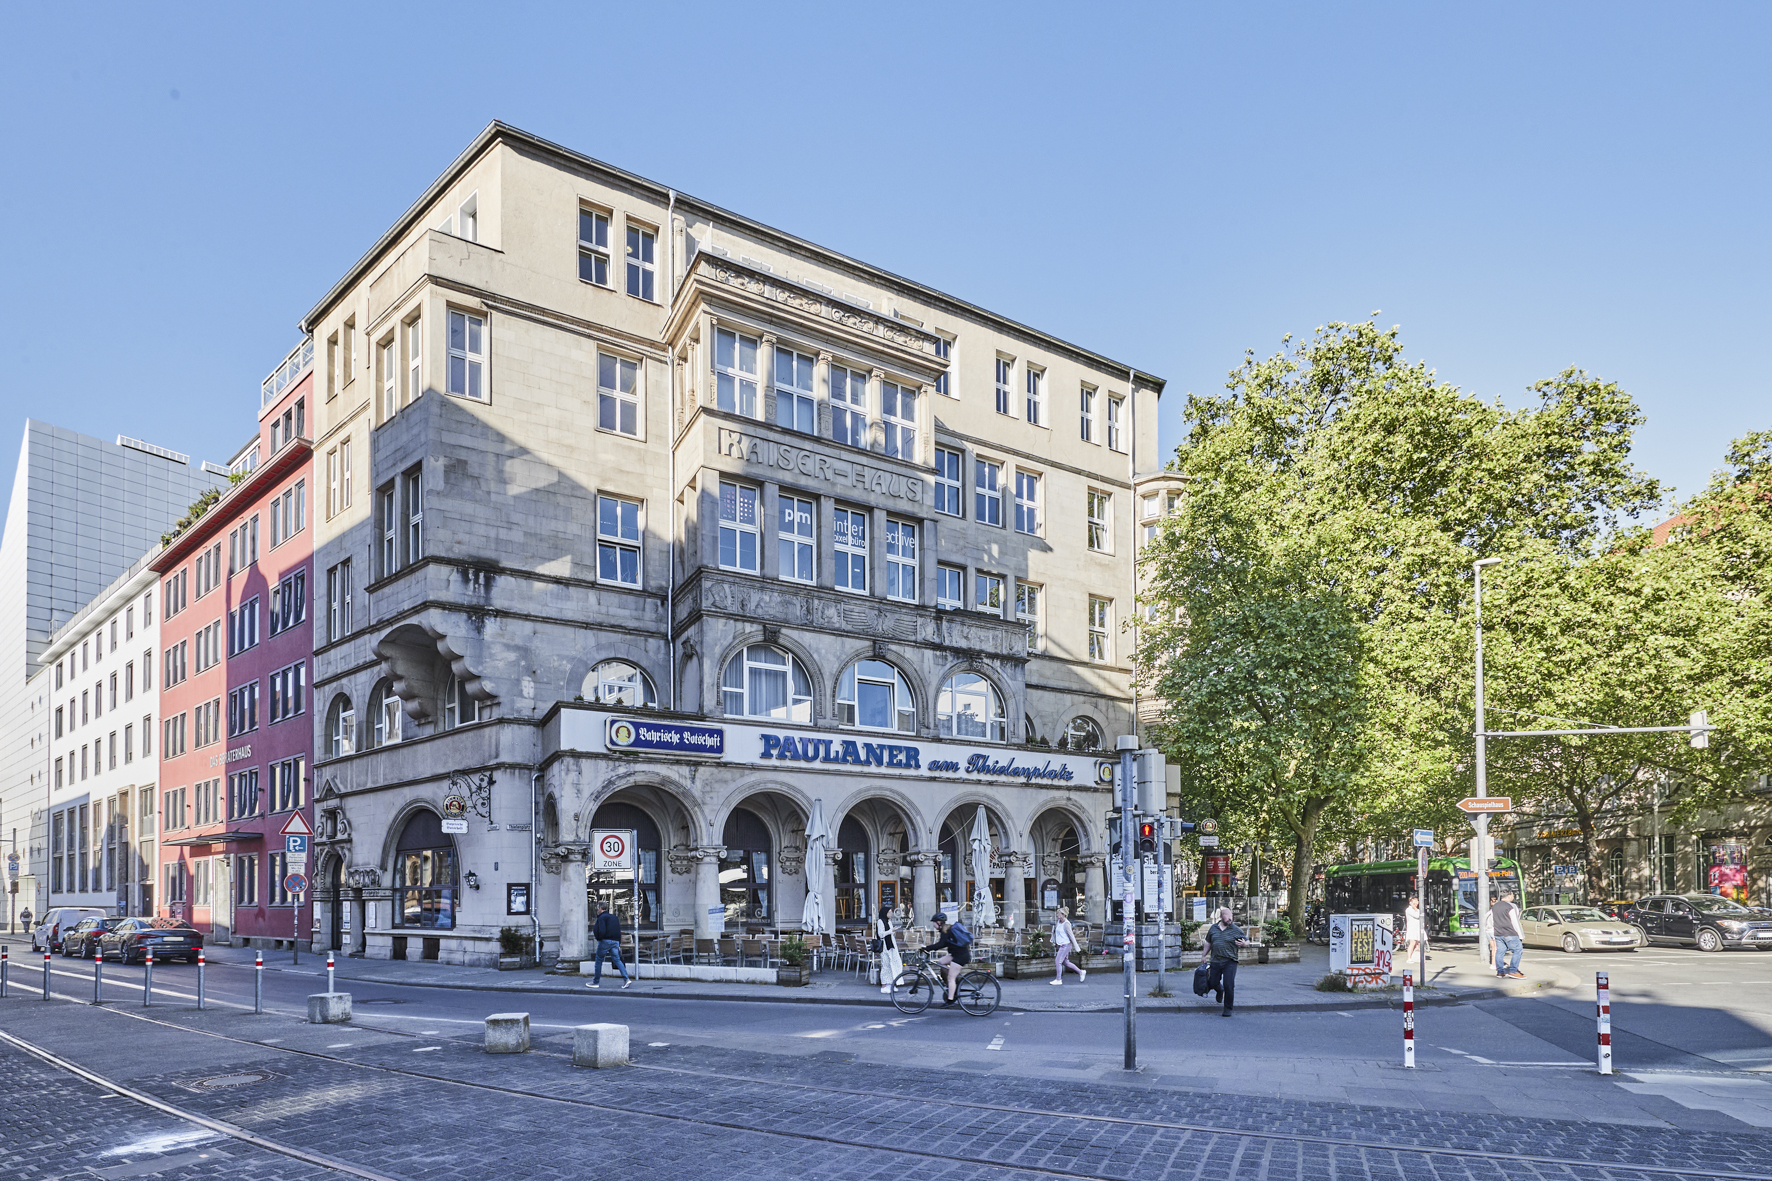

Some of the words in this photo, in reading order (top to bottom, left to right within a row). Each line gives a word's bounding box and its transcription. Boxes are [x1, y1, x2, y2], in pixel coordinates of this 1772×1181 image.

[723, 430, 923, 503] KAISER-HAUS
[785, 508, 811, 525] pm
[638, 727, 680, 746] Bayrische
[682, 731, 721, 749] Botschaft
[759, 733, 922, 769] PAULANER
[927, 759, 960, 773] am
[964, 753, 1075, 782] Thielenplatz
[1467, 801, 1505, 810] Schauspielhaus
[290, 837, 301, 851] P
[605, 841, 620, 853] 30
[603, 860, 623, 868] ZONE
[1352, 924, 1373, 939] BIER
[1352, 938, 1373, 952] FEST
